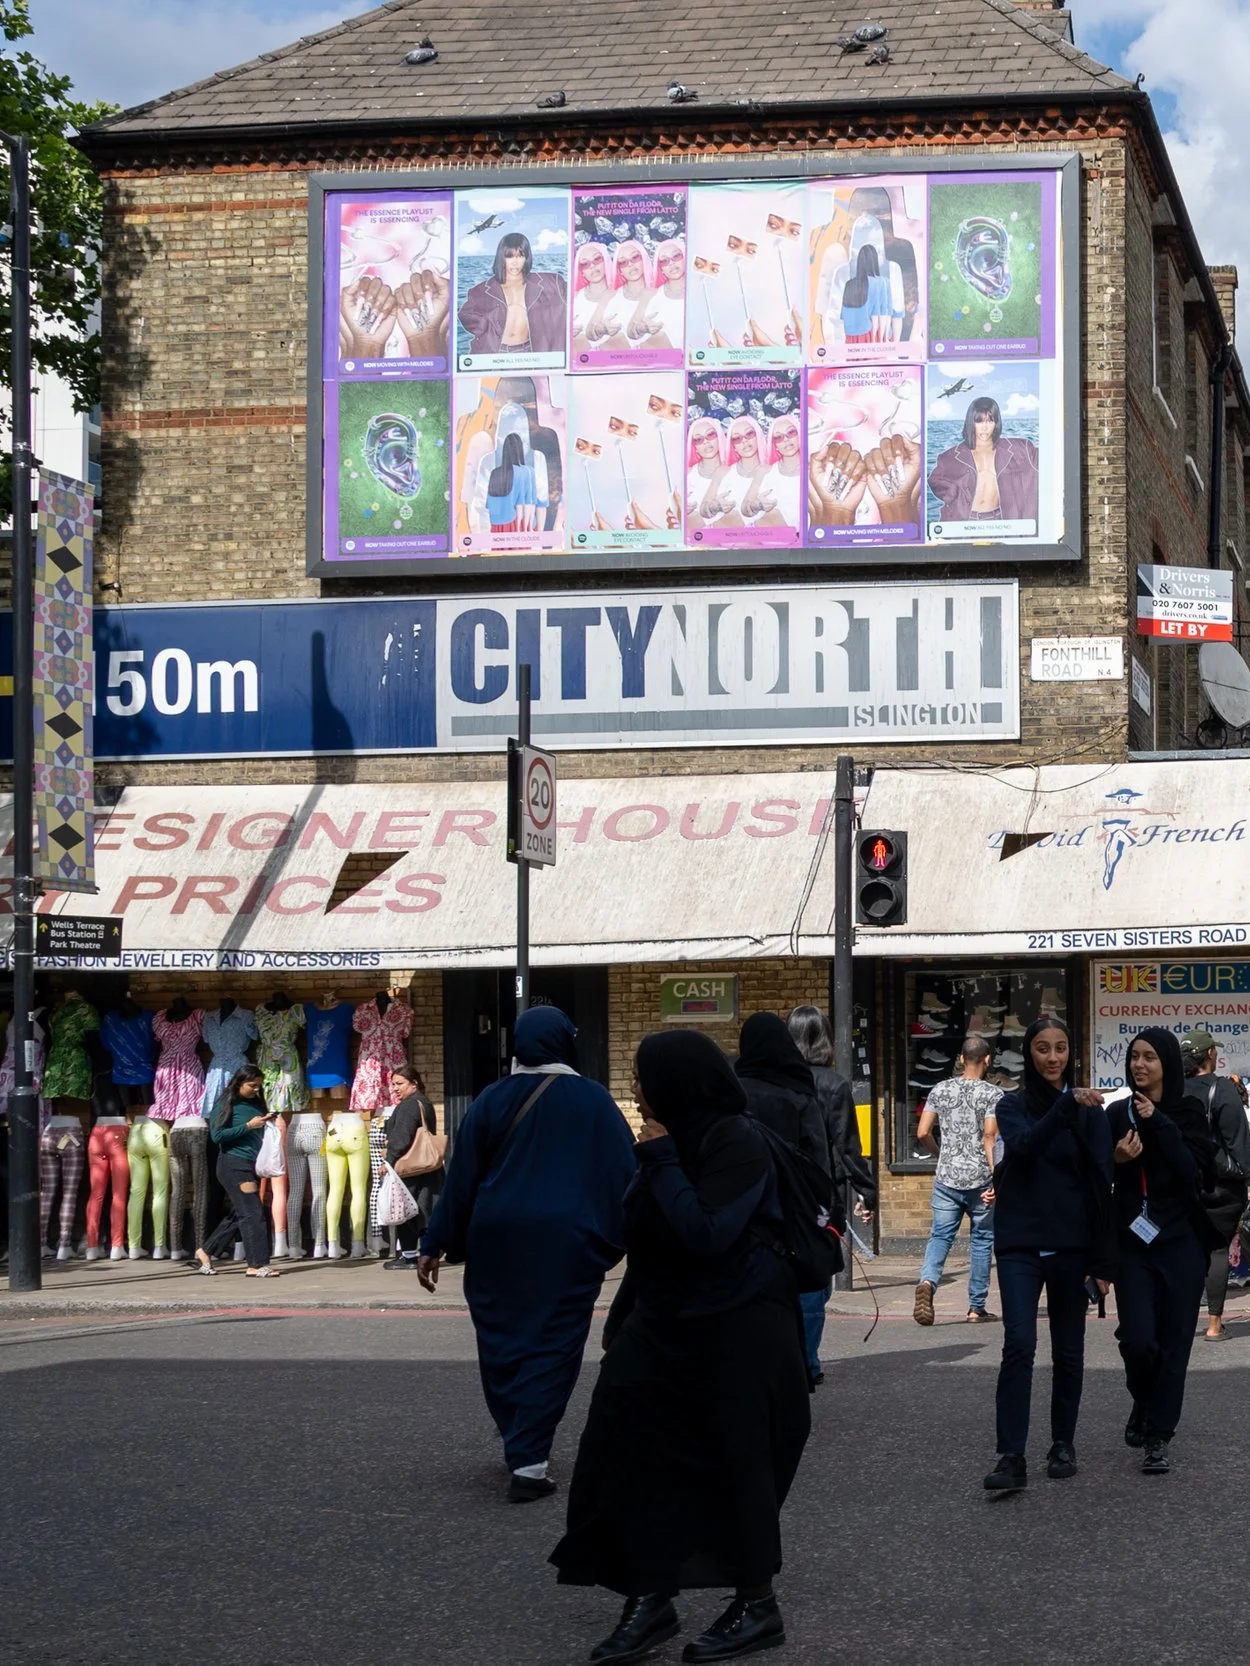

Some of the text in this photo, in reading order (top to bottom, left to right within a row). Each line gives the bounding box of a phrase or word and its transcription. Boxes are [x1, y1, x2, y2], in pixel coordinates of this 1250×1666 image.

[370, 209, 401, 217] ESSENCE
[402, 208, 434, 216] PLAYLIST
[838, 372, 870, 380] ESSENCE
[848, 379, 890, 387] ESSENCING
[1160, 568, 1210, 584] Drivers
[1152, 600, 1218, 611] 020 7607 5001
[1162, 610, 1208, 619] drivers.co.uk
[1160, 621, 1209, 637] LET BY
[1041, 647, 1112, 662] FONTHILL
[1041, 663, 1083, 677] ROAD
[93, 647, 259, 716] 50m
[531, 777, 550, 809] 20
[1136, 820, 1247, 847] French
[527, 833, 552, 855] ZONE
[51, 921, 105, 931] Wells Terrace
[51, 929, 96, 938] Bus Station
[1028, 929, 1247, 948] 221 SEVEN SISTERS ROAD
[70, 941, 101, 949] Theatre
[38, 951, 381, 968] FASHION JEWELLERY AND ACCESSORIES
[1106, 965, 1152, 993] UK
[673, 981, 725, 997] CASH
[1100, 1005, 1181, 1017] CURRENCY
[1173, 1022, 1190, 1033] de
